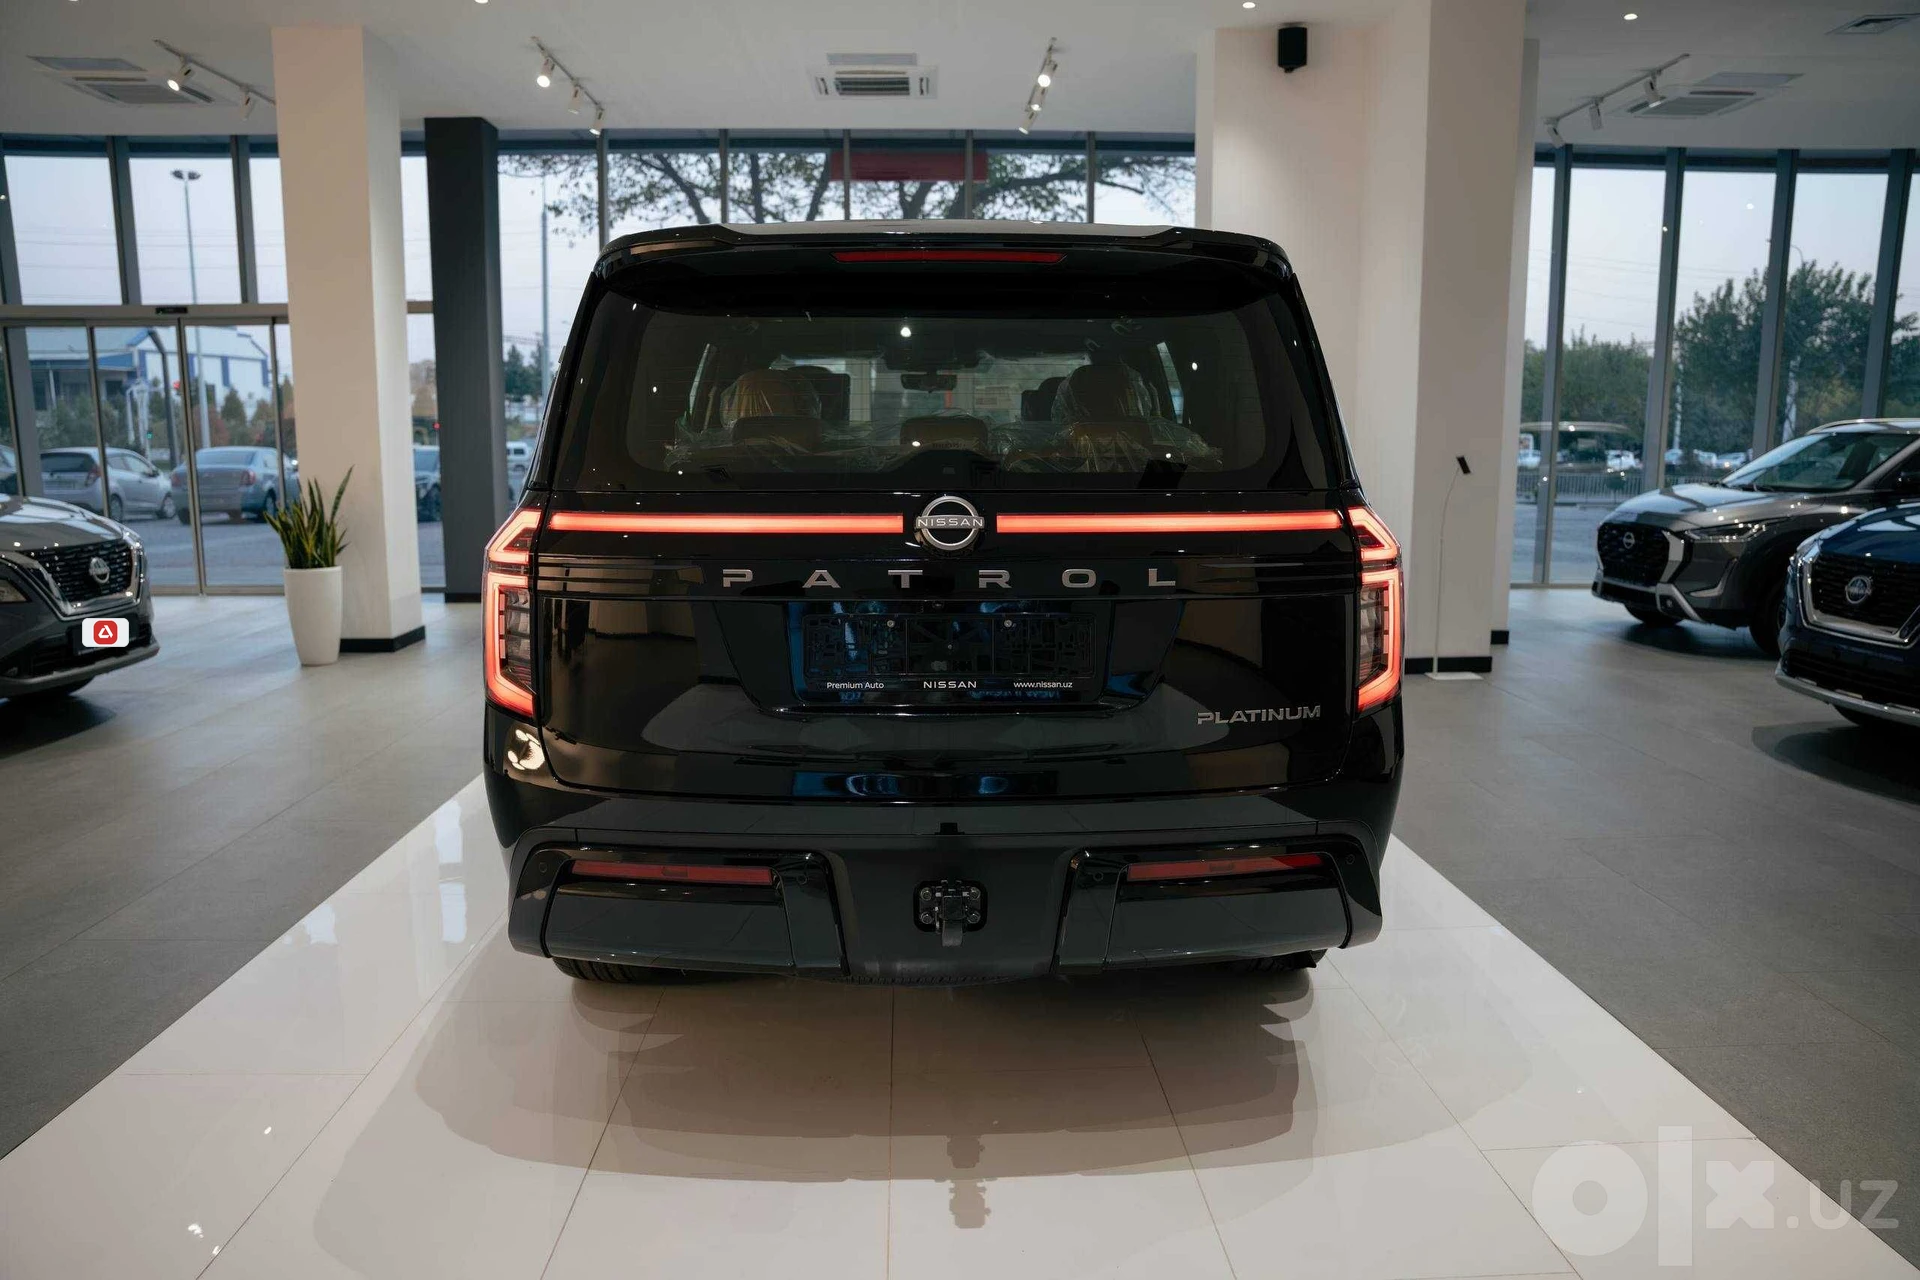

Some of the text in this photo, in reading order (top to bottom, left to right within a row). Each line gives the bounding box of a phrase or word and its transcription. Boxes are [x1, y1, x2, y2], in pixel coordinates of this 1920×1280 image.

[917, 518, 983, 527] NISSAN
[722, 568, 1176, 589] PATROL
[826, 681, 885, 689] Premium Auto
[923, 681, 977, 689] NISSAN
[1197, 705, 1321, 725] PLATINUM
